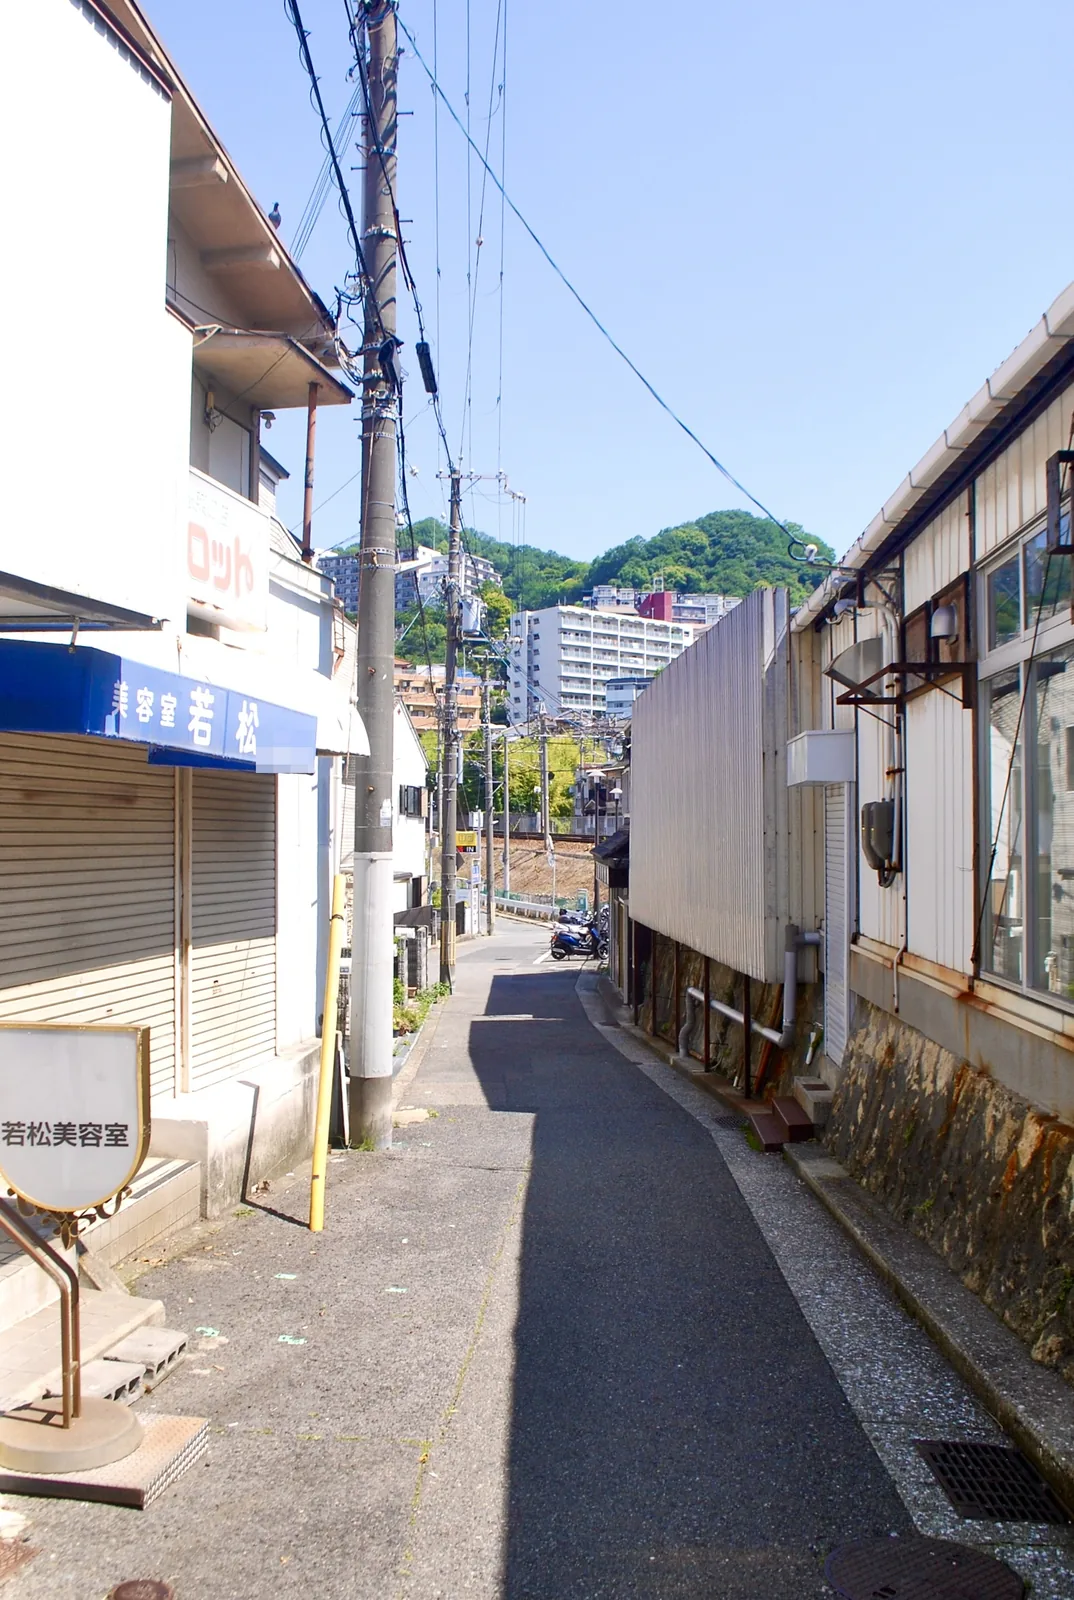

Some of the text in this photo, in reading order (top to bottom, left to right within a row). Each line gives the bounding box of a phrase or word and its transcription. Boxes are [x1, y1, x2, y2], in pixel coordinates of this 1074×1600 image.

[112, 680, 177, 728] 美容室
[1, 1121, 130, 1148] 若松美容室
